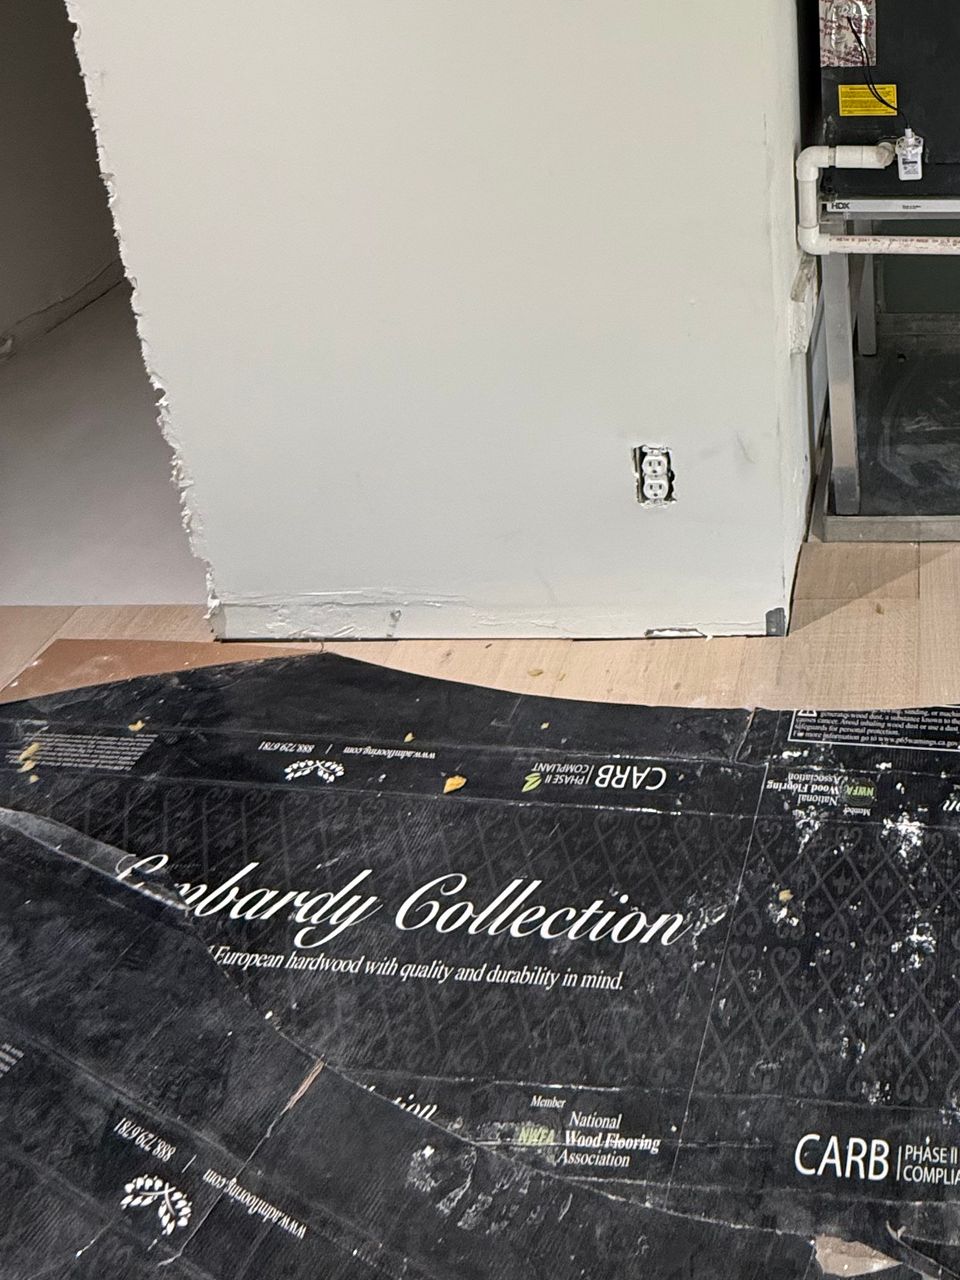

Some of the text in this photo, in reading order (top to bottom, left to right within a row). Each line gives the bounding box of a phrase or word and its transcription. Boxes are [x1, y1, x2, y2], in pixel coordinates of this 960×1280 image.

[831, 201, 850, 210] HDX
[887, 721, 904, 729] wood
[905, 722, 919, 730] dust
[258, 740, 436, 761] www.admflooring.com 888.729.6781
[530, 762, 590, 774] COMPLIANT
[594, 764, 667, 791] CARB
[552, 773, 586, 785] PHASE
[766, 780, 840, 795] Wood Flooring
[787, 772, 842, 785] Association
[797, 794, 839, 806] National
[846, 785, 875, 797] NWFA
[842, 806, 871, 817] Member
[113, 853, 694, 948] Lmbardy Collection
[215, 946, 285, 970] European
[284, 950, 363, 976] hardwood
[364, 954, 400, 976] with
[400, 958, 453, 985] quality
[454, 963, 485, 983] and
[486, 964, 560, 990] durability
[562, 969, 579, 988] in
[579, 969, 625, 991] mind.
[530, 1094, 567, 1109] Member
[568, 1110, 623, 1130] National
[518, 1127, 556, 1146] NWFA
[563, 1129, 661, 1154] Wood Flooring
[556, 1148, 630, 1168] Association
[793, 1132, 890, 1181] CARB
[903, 1142, 948, 1166] PHASE
[113, 1117, 307, 1240] www.admflooring.com 888.729.6781
